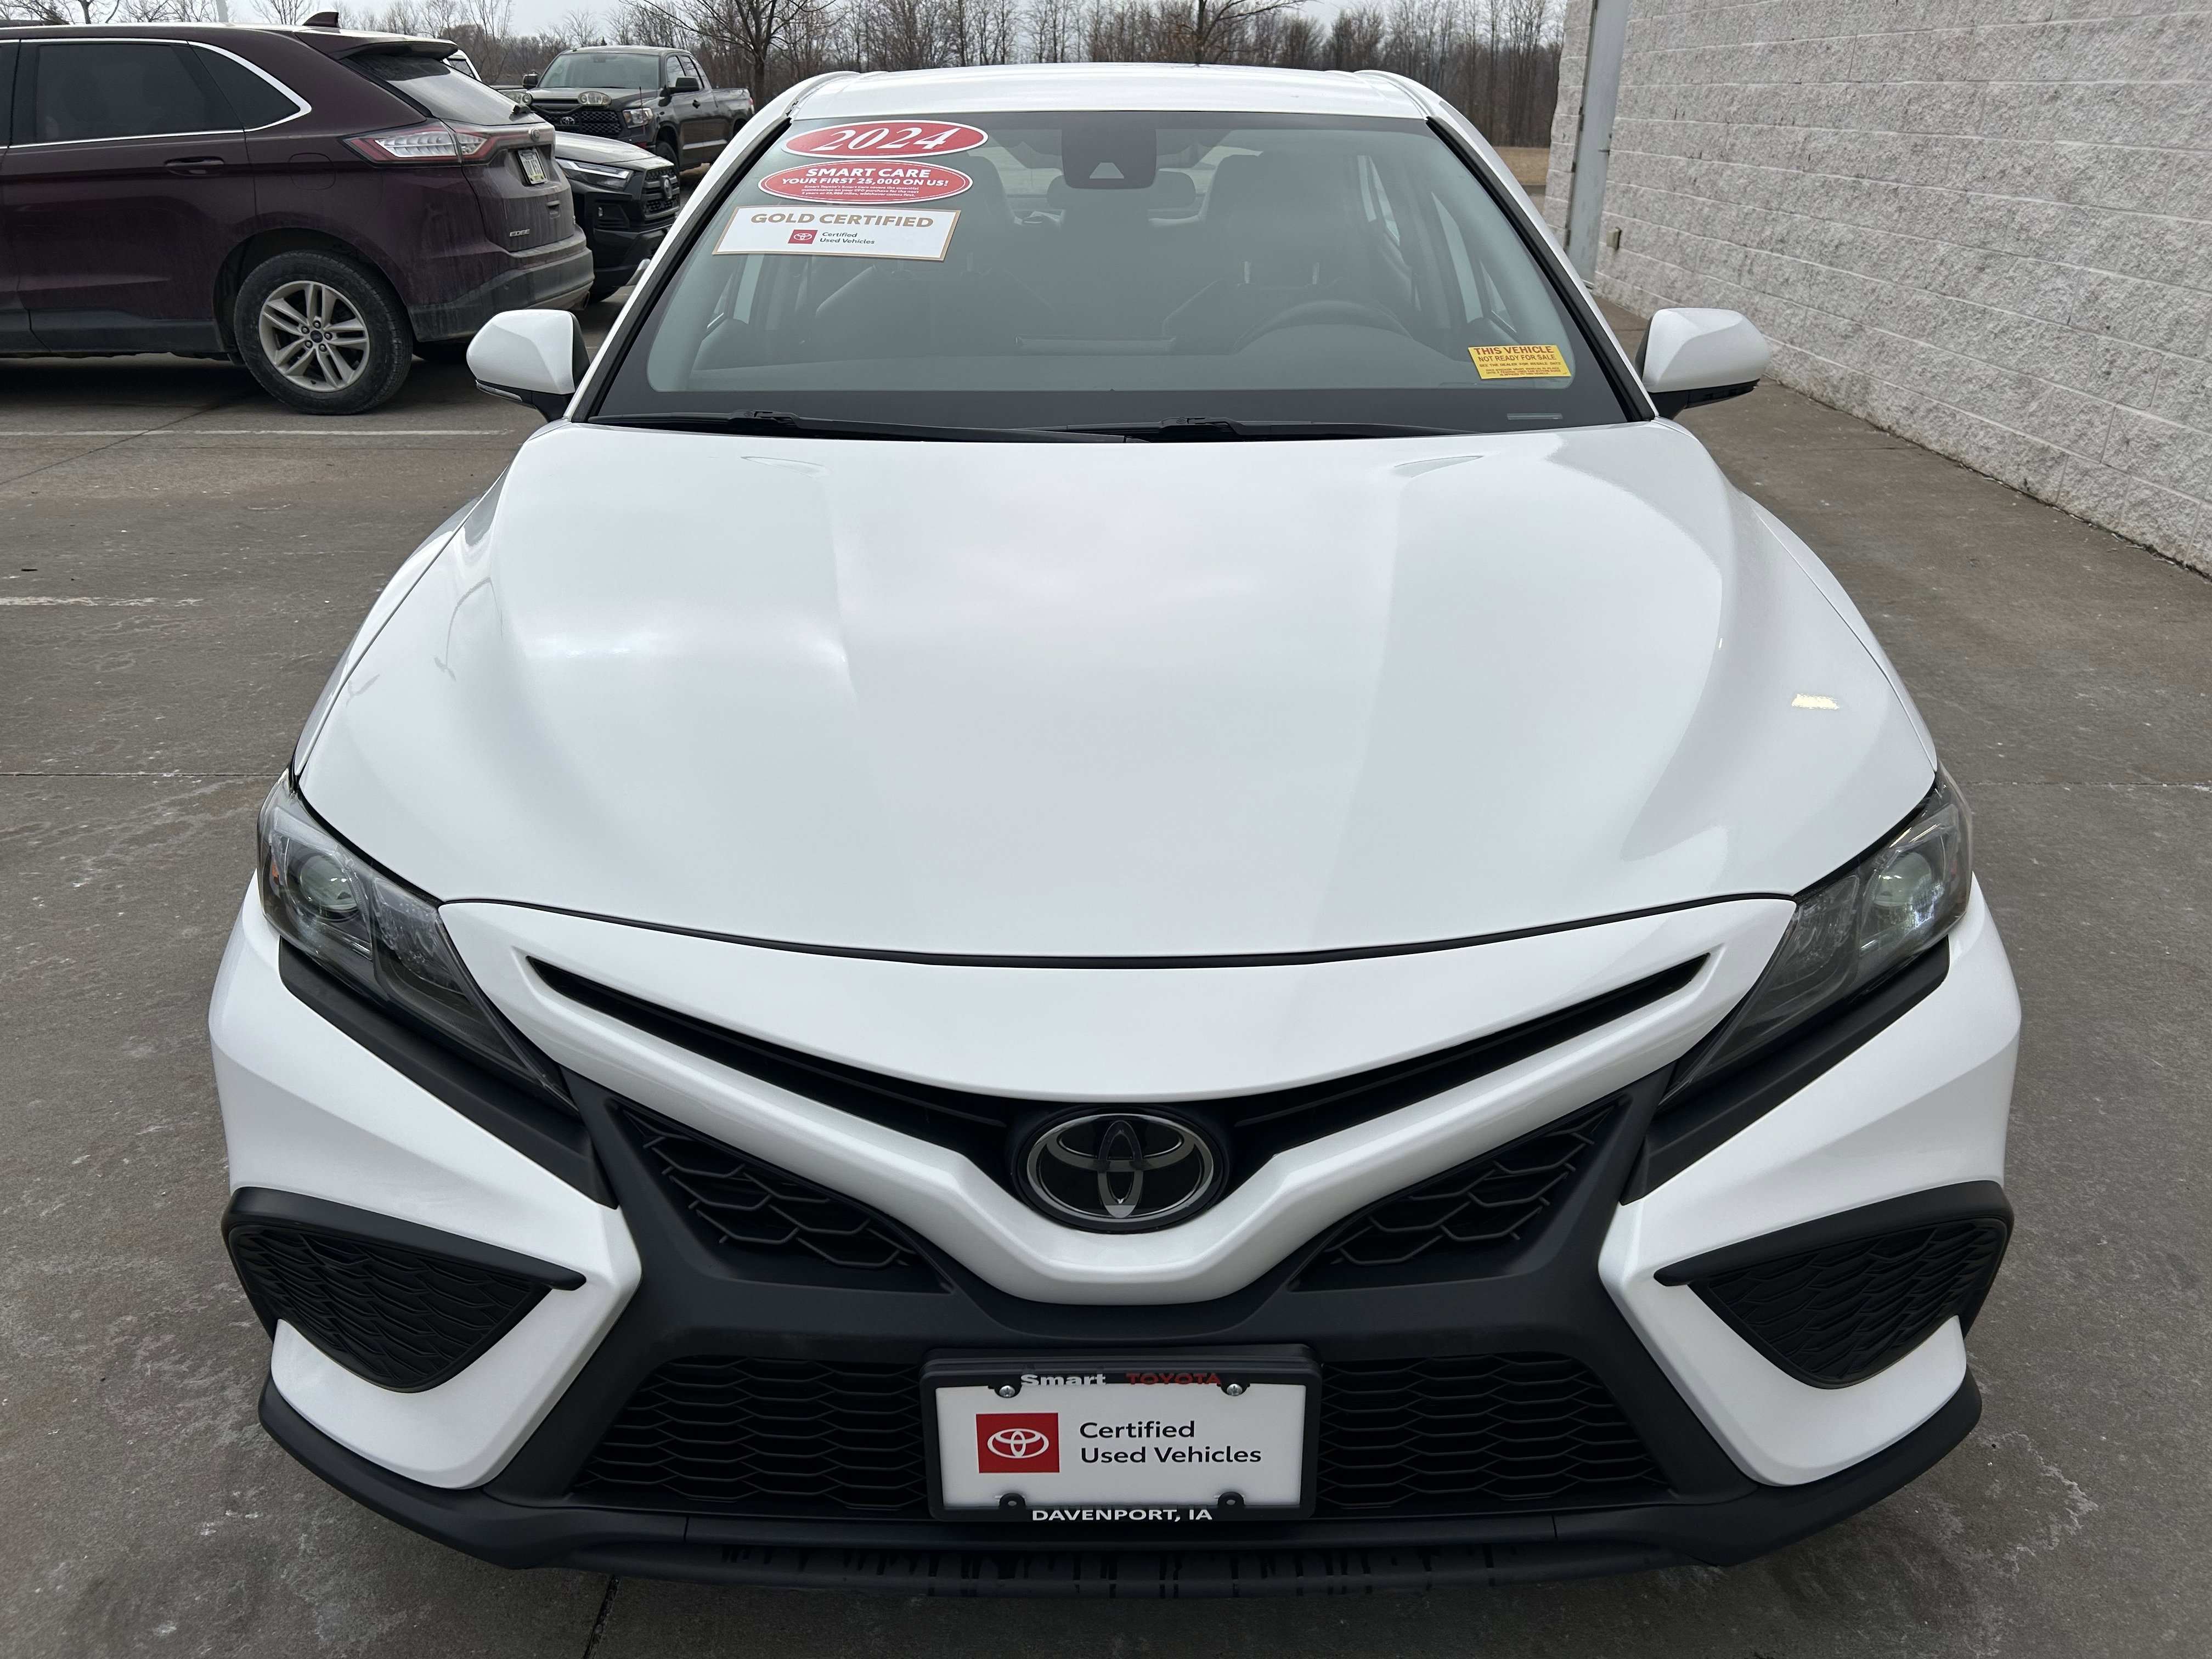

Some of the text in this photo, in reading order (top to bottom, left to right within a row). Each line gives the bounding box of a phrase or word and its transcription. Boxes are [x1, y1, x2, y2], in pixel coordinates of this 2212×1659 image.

[810, 127, 961, 151] 2024
[805, 168, 932, 178] SMART CARE
[857, 178, 900, 187] 25,000
[751, 213, 934, 228] GOLD CERTIFIED
[1474, 346, 1554, 356] THIS VEHICLE
[1021, 1373, 1221, 1386] Smart TOYOTA
[1080, 1420, 1195, 1439] Certified
[1080, 1445, 1262, 1464] Used Vehicles
[1032, 1509, 1212, 1522] DAVENPORT, IA
